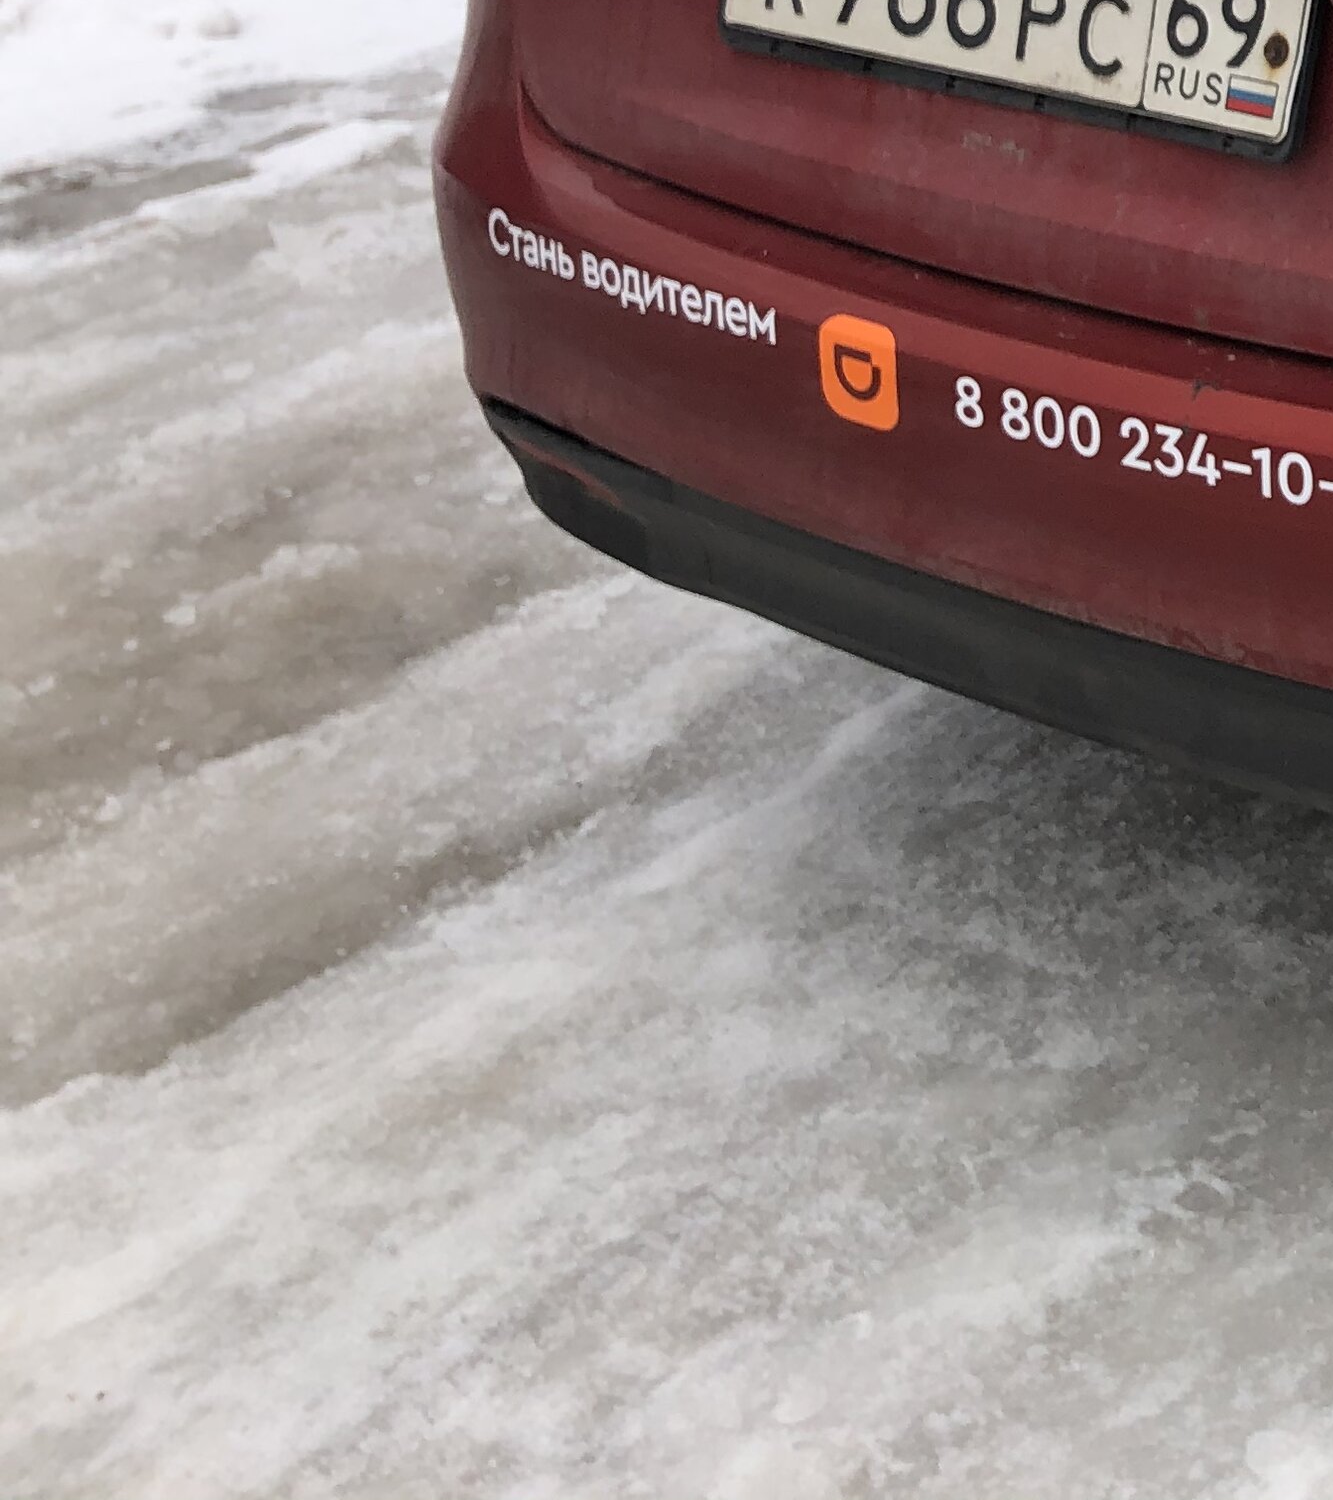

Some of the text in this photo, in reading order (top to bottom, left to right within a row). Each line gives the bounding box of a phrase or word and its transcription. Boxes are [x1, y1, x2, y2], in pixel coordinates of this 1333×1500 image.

[1153, 62, 1223, 106] RUS
[488, 207, 777, 346] Стань водителем
[954, 376, 985, 428] 8
[1001, 388, 1102, 459] 800
